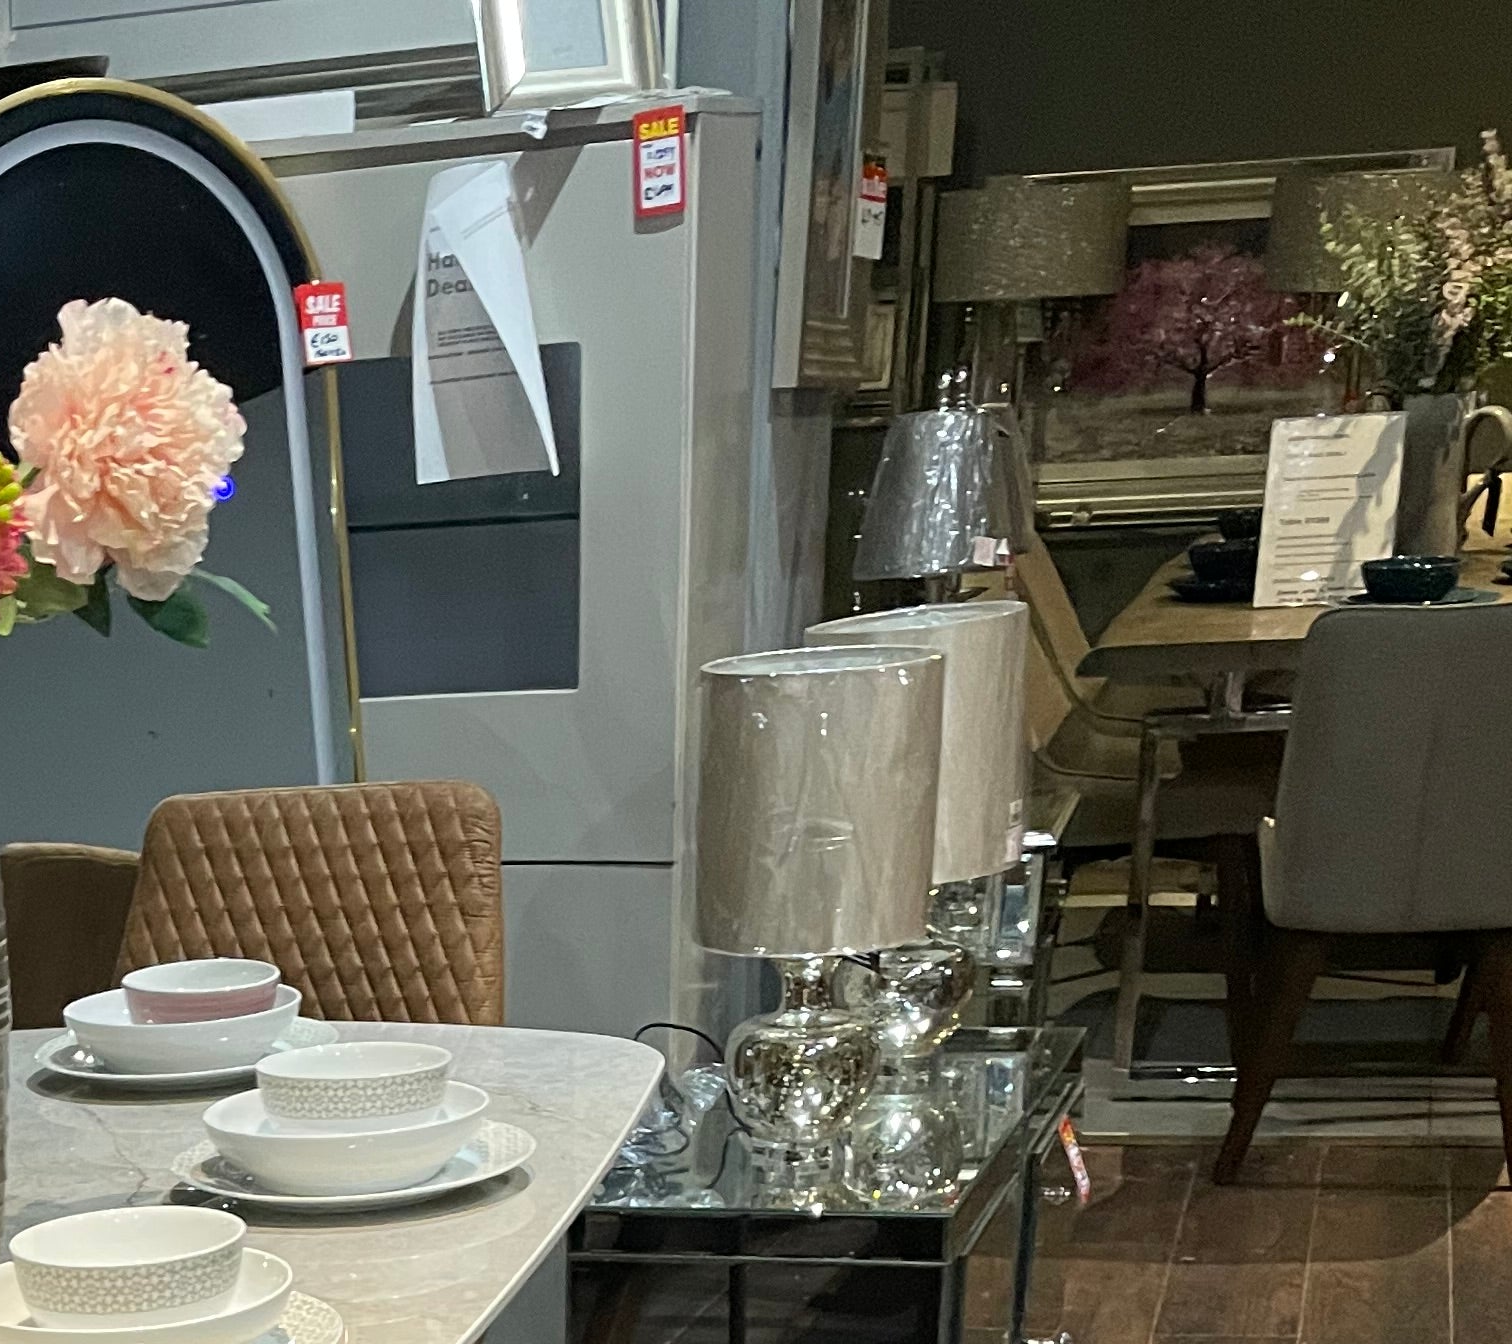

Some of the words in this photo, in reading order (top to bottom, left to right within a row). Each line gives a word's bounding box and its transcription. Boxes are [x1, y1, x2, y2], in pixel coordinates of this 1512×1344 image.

[639, 117, 679, 141] SALE
[427, 250, 459, 271] Ha
[305, 294, 341, 314] SALE
